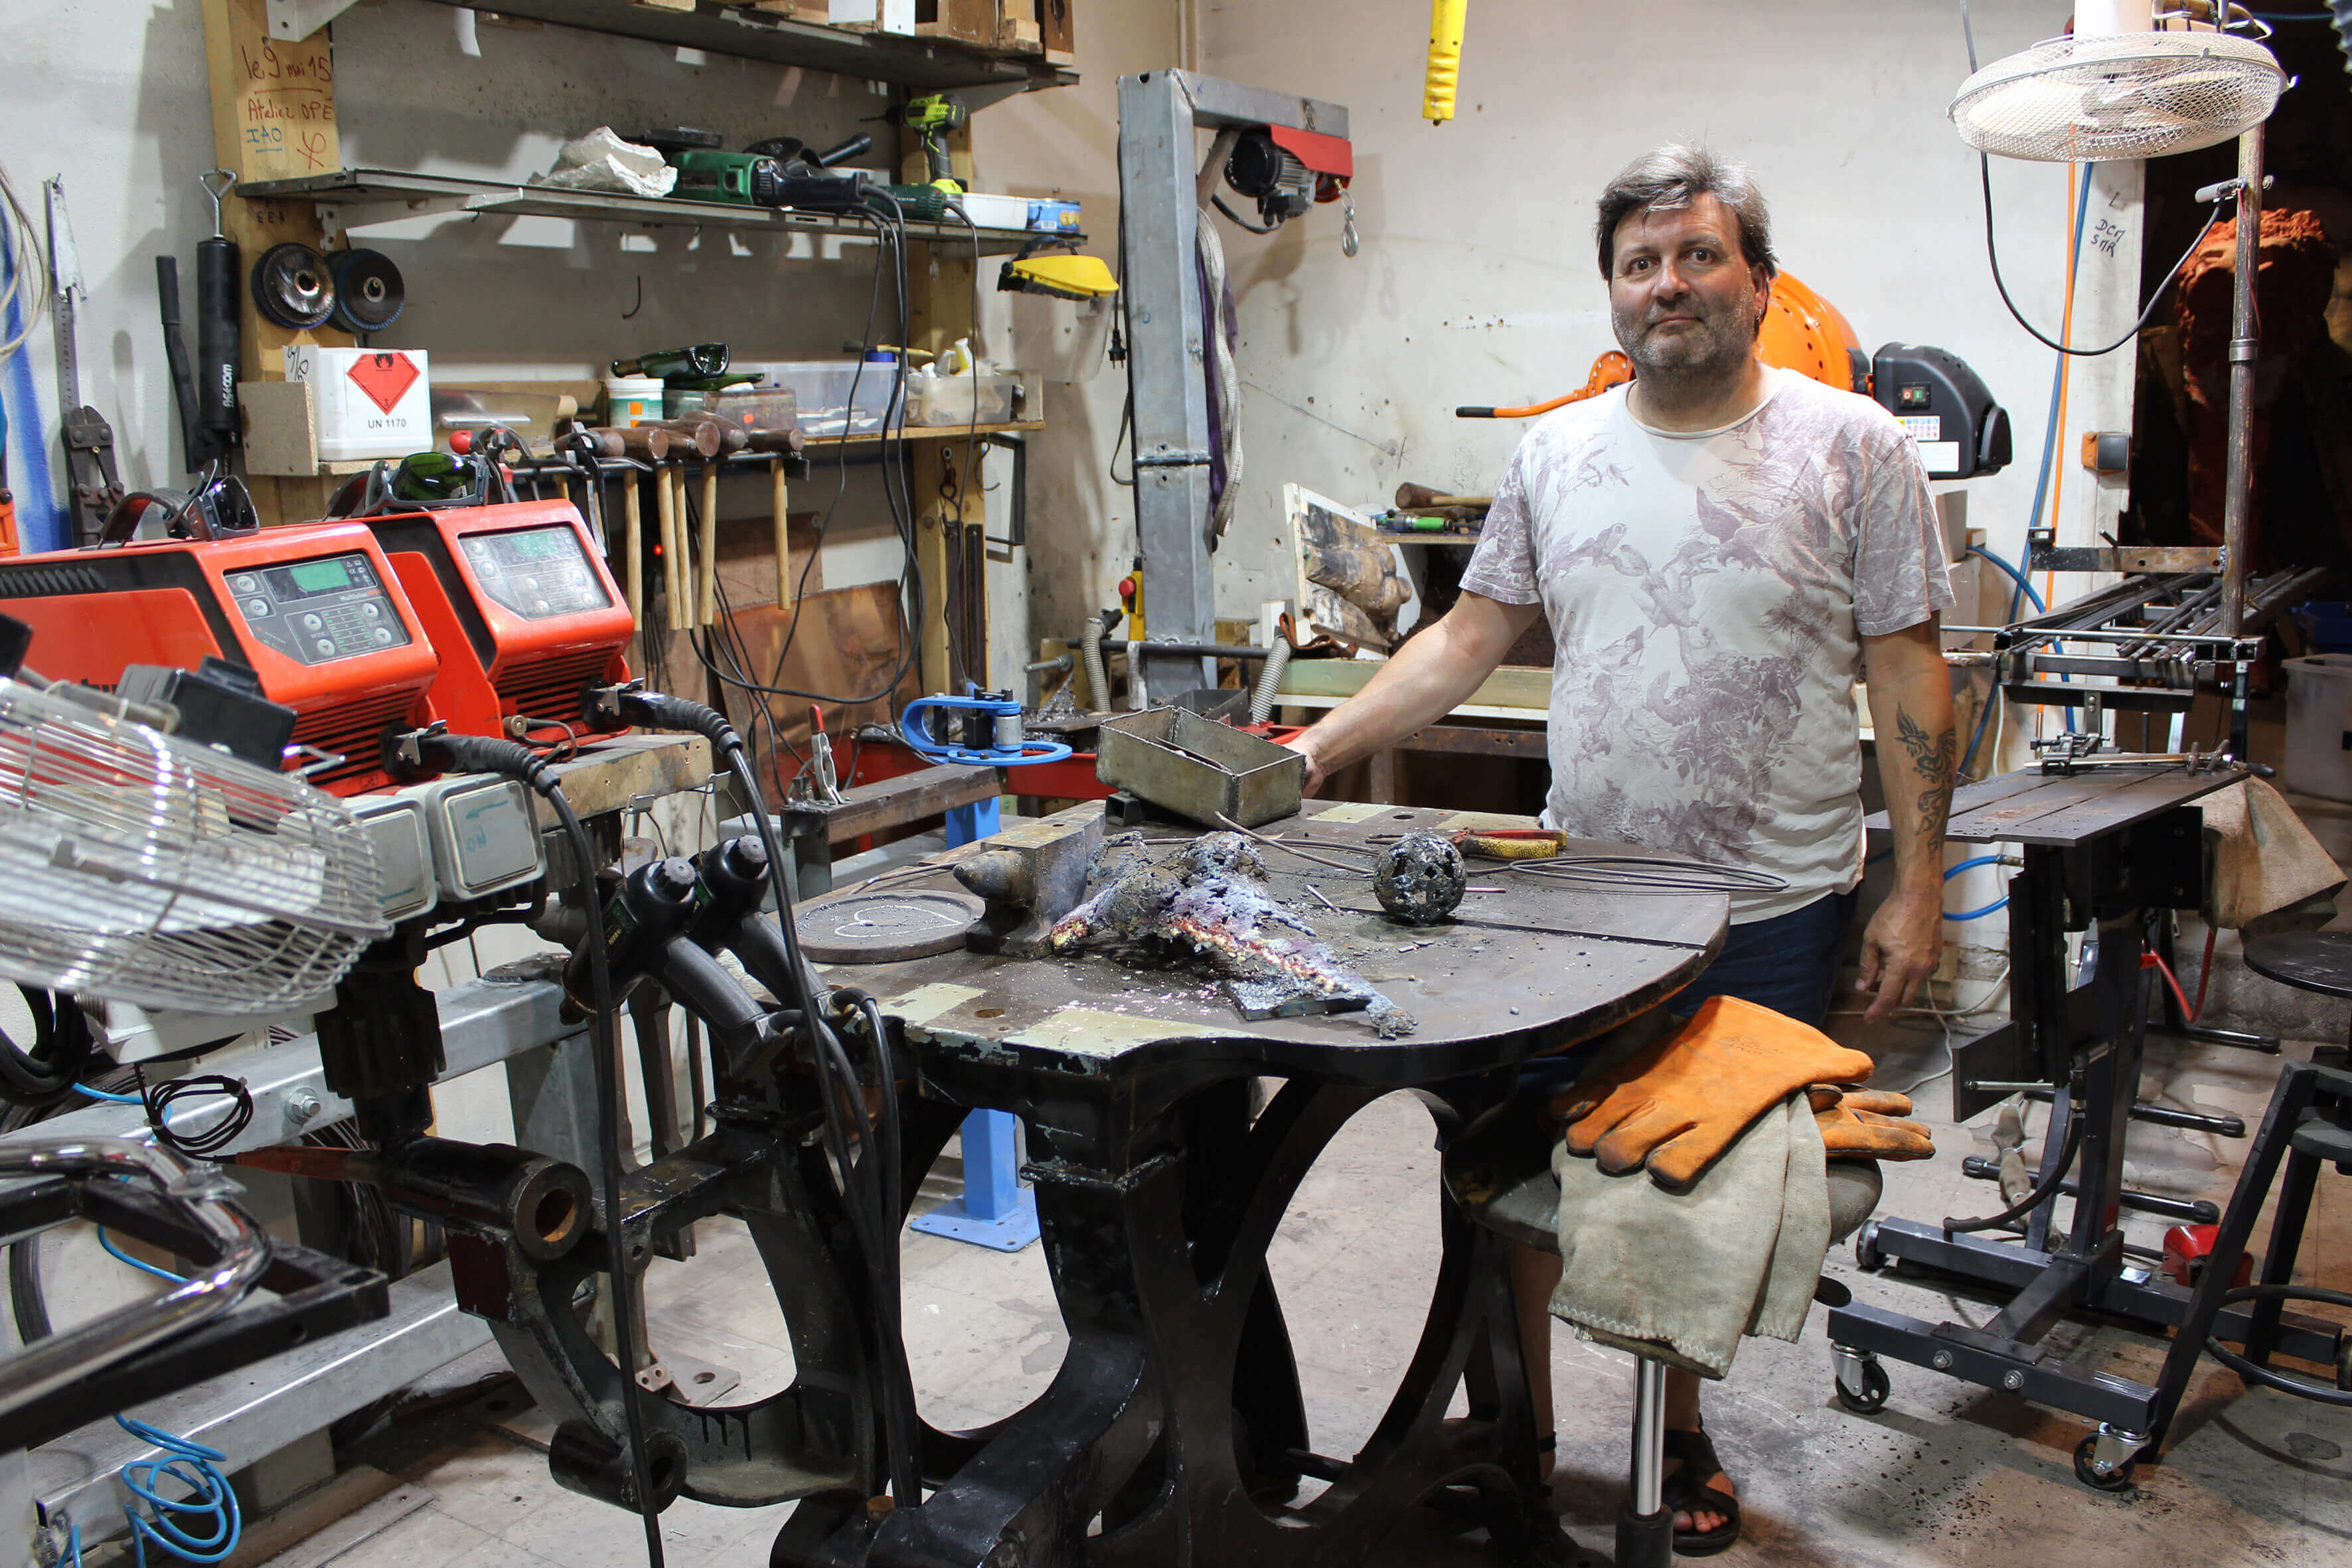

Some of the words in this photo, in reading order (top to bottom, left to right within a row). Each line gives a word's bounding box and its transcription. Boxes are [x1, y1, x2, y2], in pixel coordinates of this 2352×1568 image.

[307, 55, 332, 82] 15
[367, 419, 382, 429] UN
[386, 418, 407, 428] 1170
